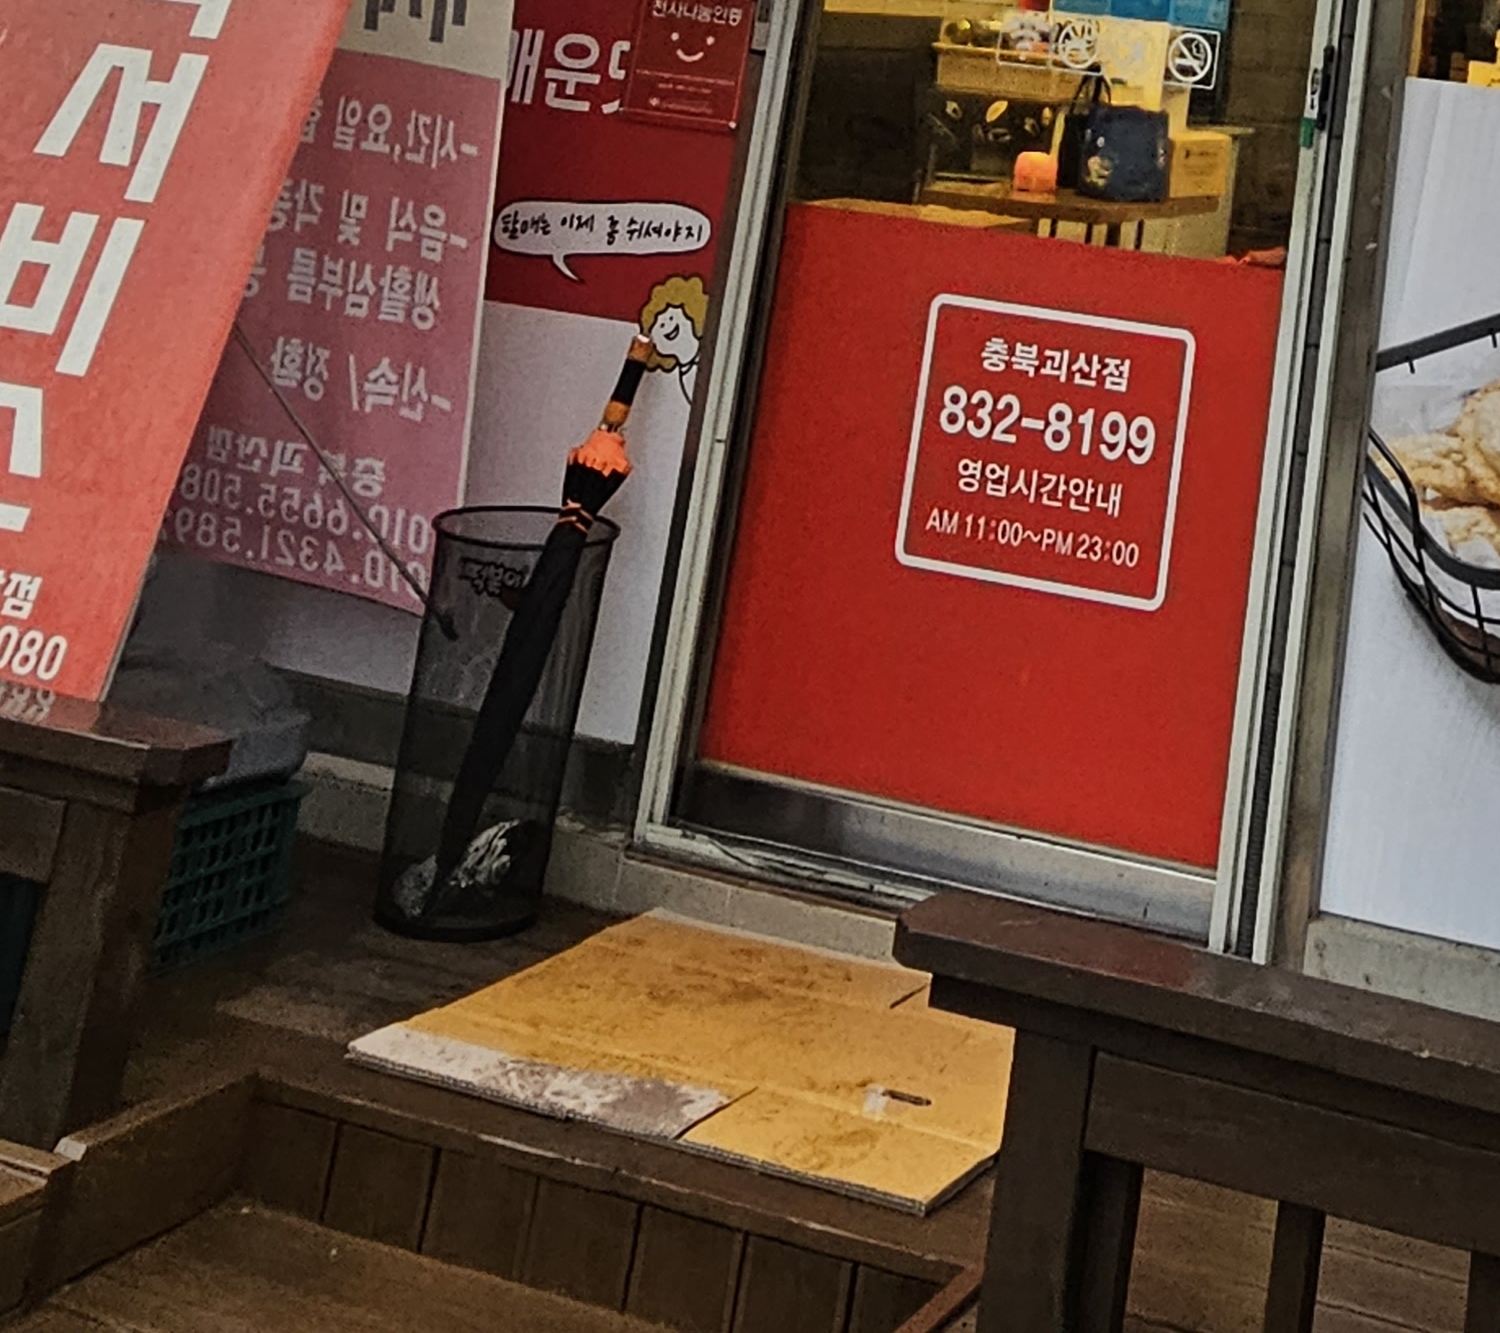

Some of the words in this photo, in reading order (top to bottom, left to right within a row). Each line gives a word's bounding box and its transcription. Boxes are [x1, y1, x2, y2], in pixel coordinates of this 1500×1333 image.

[559, 212, 595, 233] 이제
[980, 337, 1132, 393] 충북괴산점
[938, 384, 1157, 466] 832-8199
[956, 458, 1124, 518] 영업시간안내
[925, 508, 960, 535] AM
[1076, 533, 1140, 569] 23:00
[0, 569, 43, 620] 점
